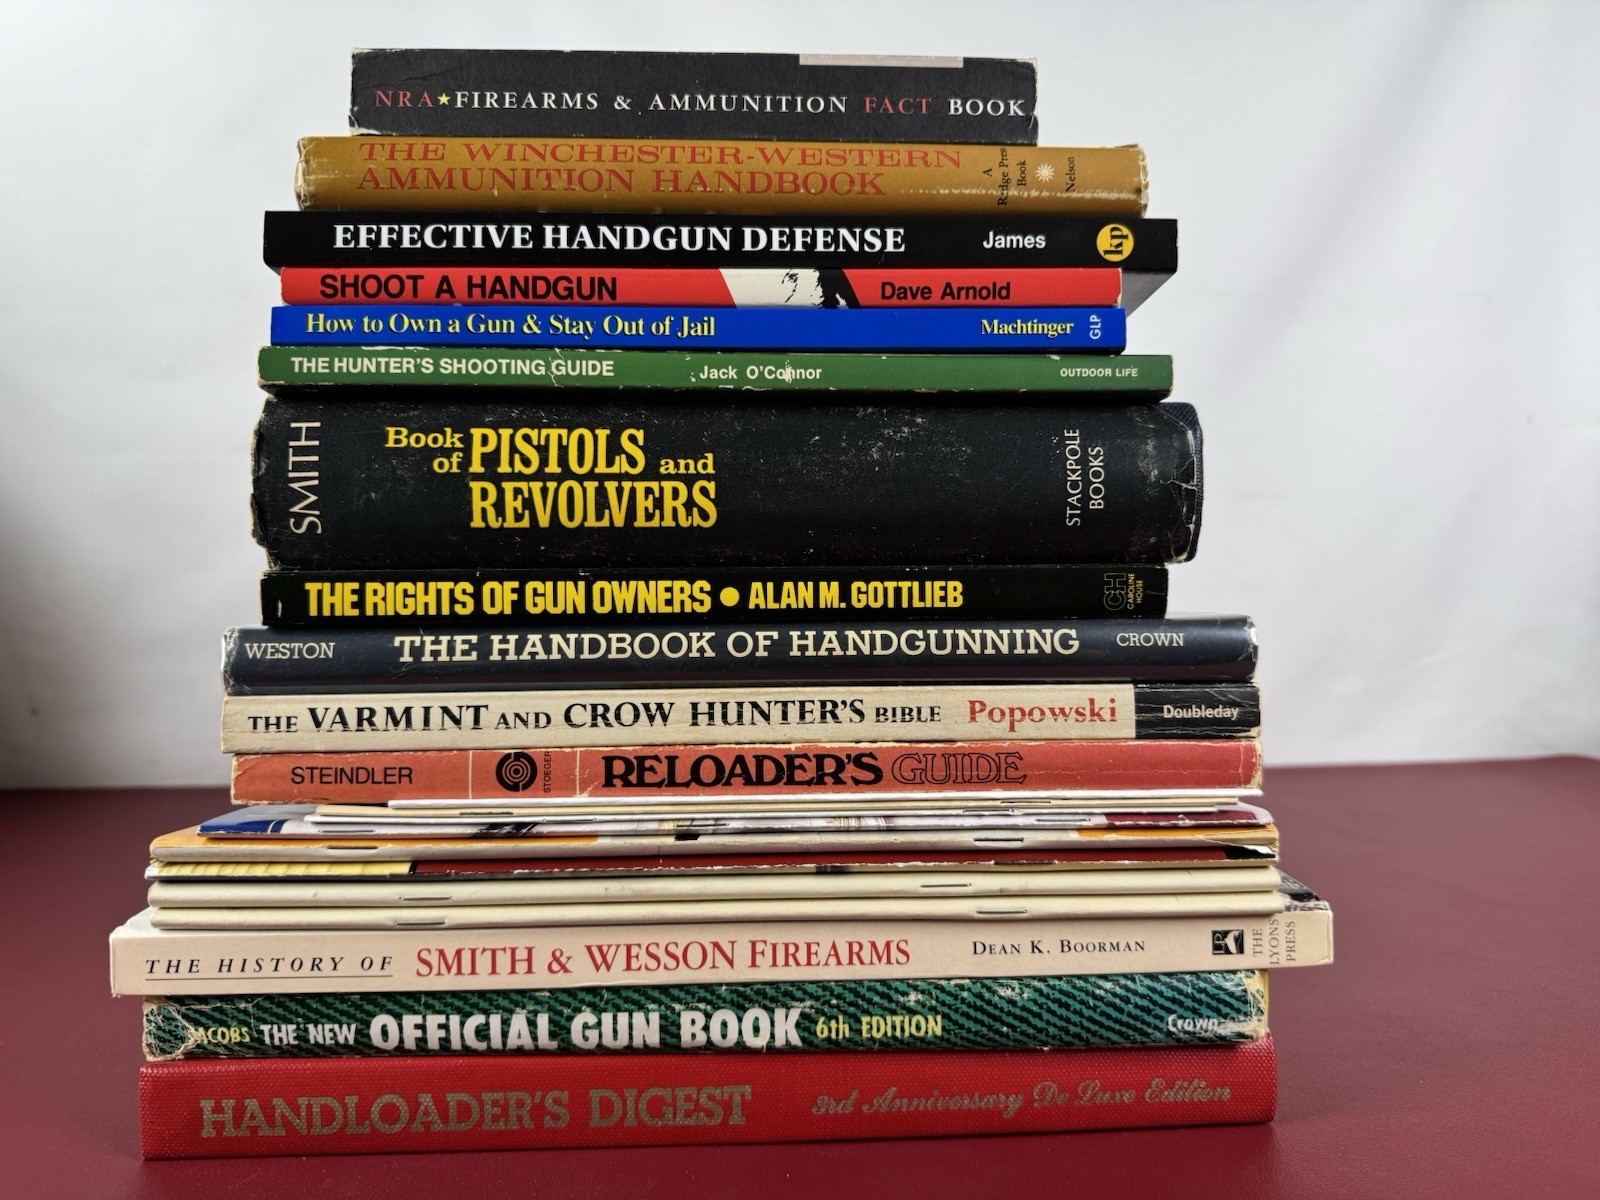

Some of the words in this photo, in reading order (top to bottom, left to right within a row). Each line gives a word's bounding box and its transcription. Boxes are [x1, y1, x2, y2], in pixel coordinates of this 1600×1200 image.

[374, 90, 434, 109] NRA
[455, 92, 599, 111] FIREARMS
[613, 95, 632, 111] &
[648, 93, 848, 114] AMMUNITION
[863, 97, 932, 115] FACT
[948, 98, 1026, 117] BOOK
[359, 142, 446, 161] THE
[463, 142, 961, 169] WINCHESTER-WESTERN
[983, 168, 993, 177] A
[356, 168, 633, 193] AMMUNITION
[652, 170, 886, 196] HANDBOOK
[1016, 160, 1027, 187] Book
[1065, 156, 1076, 192] Nelson
[333, 224, 533, 250] EFFECTIVE
[543, 225, 731, 252] HANDGUN
[742, 227, 905, 253] DEFENSE
[983, 230, 1046, 250] James
[320, 274, 424, 300] SHOOT
[435, 275, 456, 300] A
[467, 276, 618, 301] HANDGUN
[880, 281, 932, 301] Dave
[940, 281, 1011, 301] Arnold
[306, 313, 356, 334] How
[362, 316, 383, 334] to
[389, 313, 440, 335] Own
[447, 319, 460, 335] a
[467, 314, 515, 335] Gun
[522, 314, 542, 336] &
[549, 314, 597, 341] Stay
[603, 315, 645, 337] Out
[651, 315, 674, 337] of
[677, 316, 716, 340] Jail
[980, 318, 1074, 340] Machtinger
[1089, 314, 1102, 340] GLP
[291, 357, 332, 374] THE
[334, 358, 433, 375] HUNTER'S
[439, 359, 546, 376] SHOOTING
[551, 360, 615, 378] GUIDE
[700, 365, 738, 380] Jack
[1060, 368, 1113, 378] OUTDOOR
[1115, 368, 1139, 378] LIFE
[385, 427, 464, 448] Book
[432, 453, 464, 474] of
[468, 427, 645, 475] PISTOLS
[660, 453, 715, 475] and
[290, 421, 322, 534] SMITH
[1065, 428, 1081, 527] STACKPOLE
[1089, 446, 1105, 510] BOOKS
[470, 480, 717, 529] REVOLVERS
[305, 582, 360, 617] THE
[365, 581, 474, 616] RIGHTS
[483, 581, 519, 615] OF
[525, 580, 589, 615] GUN
[592, 580, 711, 614] OWNERS
[748, 582, 817, 610] ALAN
[820, 581, 846, 609] M.
[851, 580, 963, 608] GOTTLIEB
[1127, 573, 1135, 609] CAROLINE
[1135, 580, 1143, 603] HOUSE
[245, 642, 335, 660] WESTON
[394, 635, 478, 663] THE
[490, 632, 714, 661] HANDBOOK
[727, 631, 778, 658] OF
[789, 628, 1080, 657] HANDGUNNING
[1116, 631, 1184, 647] CROWN
[248, 716, 298, 732] THE
[307, 704, 489, 732] VARMINT
[495, 711, 551, 730] AND
[564, 702, 674, 728] CROW
[690, 699, 865, 729] HUNTER'S
[875, 705, 941, 723] BIBLE
[967, 697, 1117, 732] Popowski
[1163, 704, 1239, 720] Doubleday
[291, 766, 412, 785] STEINDLER
[544, 751, 552, 793] STOEGER
[602, 752, 883, 788] RELOADER'S
[891, 751, 1027, 785] GUIDE
[145, 957, 200, 974] THE
[218, 956, 344, 974] HISTORY
[360, 955, 393, 973] OF
[416, 946, 534, 976] SMITH
[547, 947, 573, 974] &
[584, 941, 735, 974] WESSON
[748, 938, 910, 969] FIREARMS
[972, 940, 1022, 956] DEAN
[1030, 939, 1051, 956] K.
[1059, 937, 1146, 955] BOORMAN
[1252, 929, 1263, 957] THE
[1269, 919, 1280, 965] LYONS
[1285, 921, 1295, 961] PRESS
[260, 1024, 297, 1045] THE
[307, 1023, 357, 1044] NEW
[370, 1012, 559, 1051] OFFICIAL
[570, 1011, 661, 1050] GUN
[680, 1008, 801, 1048] BOOK
[815, 1017, 849, 1039] 6th
[861, 1015, 942, 1038] EDITION
[1167, 1014, 1219, 1032] Crown
[200, 1088, 569, 1138] HANDLOADER'S
[588, 1084, 751, 1128] DIGEST
[811, 1089, 858, 1115] 3rd
[862, 1086, 1024, 1118] Anniversary
[1033, 1080, 1069, 1107] De
[1076, 1079, 1136, 1105] Luxe
[1144, 1077, 1231, 1102] Edition
